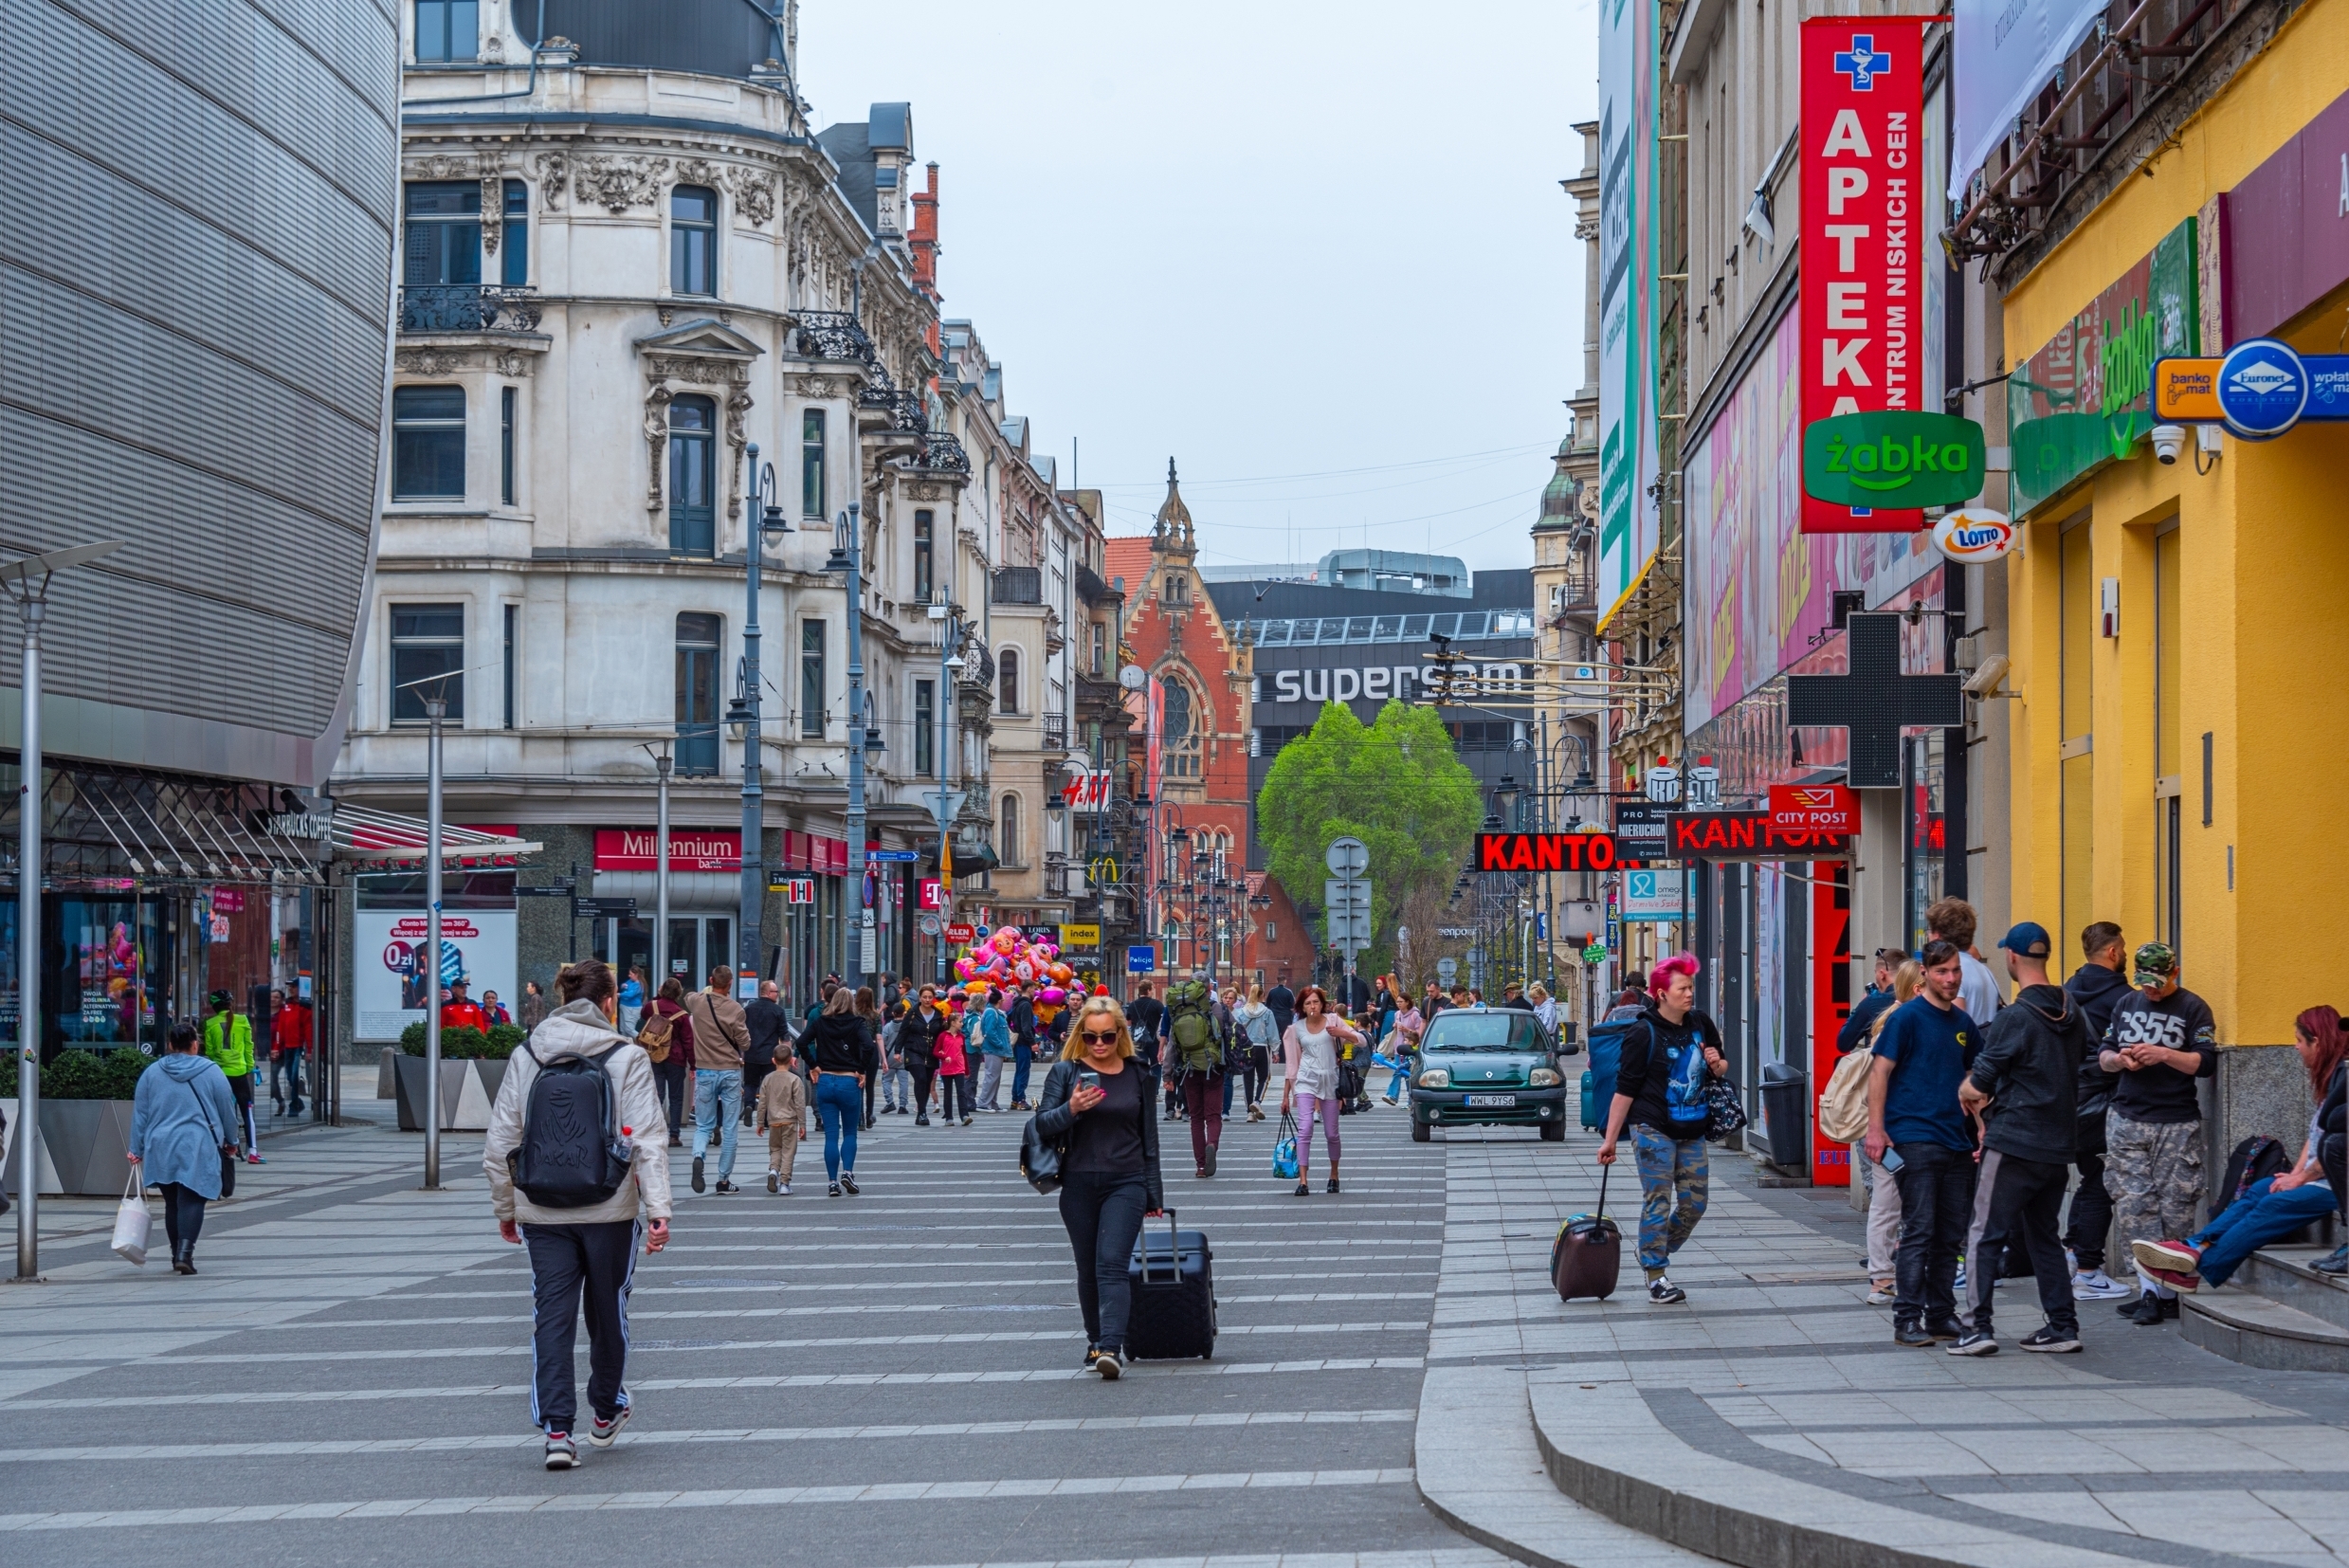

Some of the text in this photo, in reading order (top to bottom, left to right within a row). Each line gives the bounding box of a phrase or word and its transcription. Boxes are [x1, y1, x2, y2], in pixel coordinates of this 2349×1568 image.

[1886, 112, 1907, 169] CEN
[1886, 179, 1907, 297] NISKICH
[2102, 299, 2155, 419] żabka
[2171, 373, 2212, 384] banko
[2186, 385, 2212, 394] mat
[2240, 372, 2285, 383] Euronet
[1825, 433, 1968, 472] żabka
[1958, 528, 1998, 546] LOTTO
[1276, 662, 1522, 704] supersam
[1061, 775, 1109, 808] H&M
[310, 814, 332, 841] COFFEE
[1775, 811, 1848, 824] CITY POST
[699, 858, 722, 868] bank
[1483, 834, 1642, 871] KANTO
[385, 944, 413, 966] 0 zł
[1129, 955, 1153, 964] Policja
[1470, 1096, 1514, 1105] WWL 9YS6
[532, 1140, 592, 1169] DAKAR
